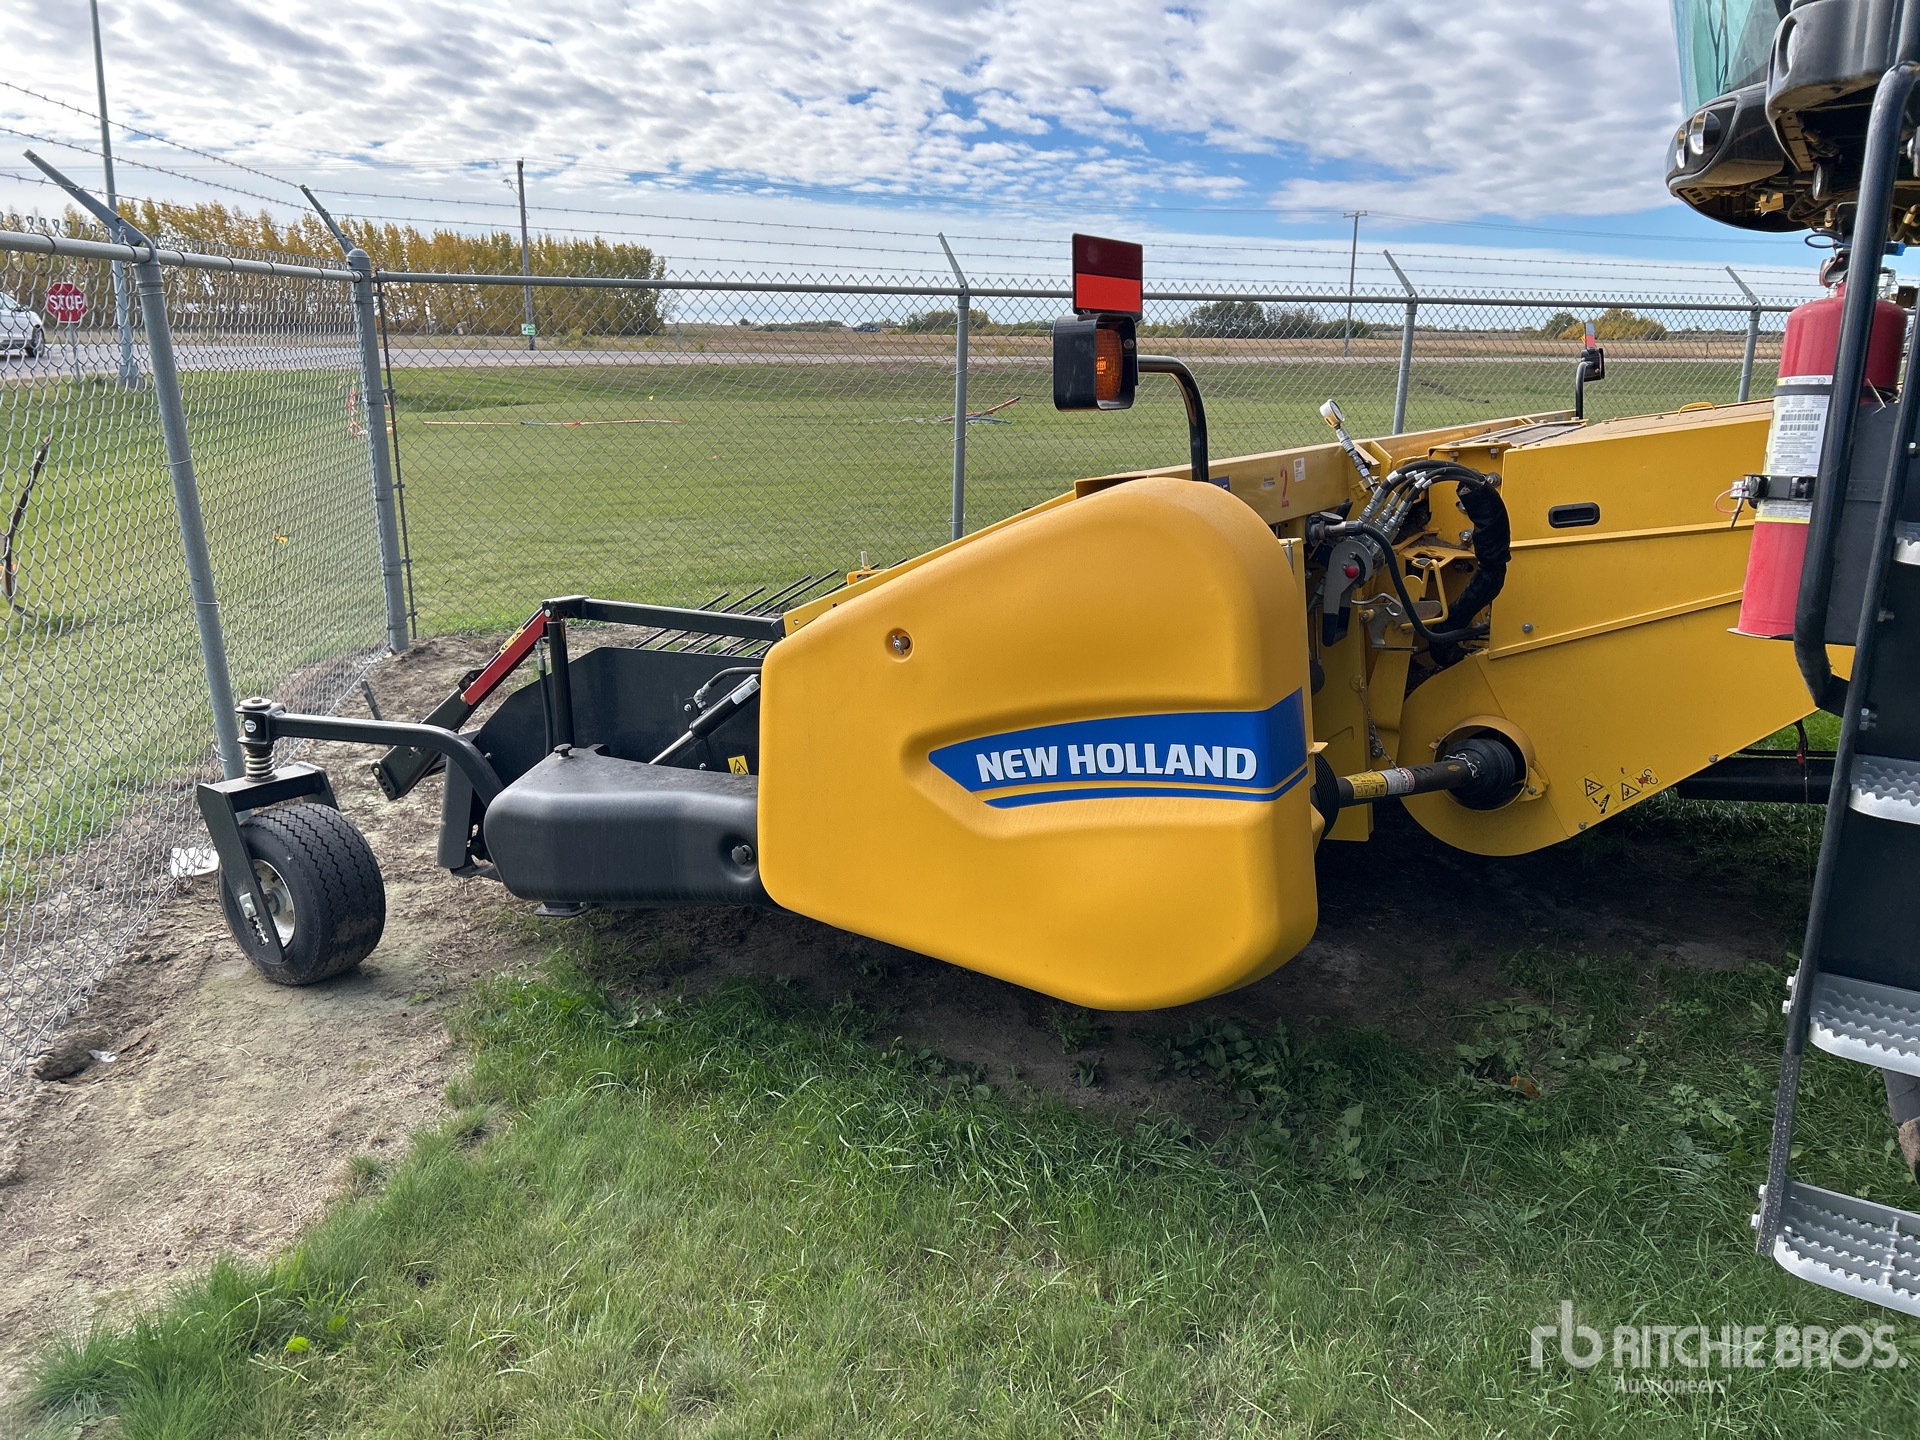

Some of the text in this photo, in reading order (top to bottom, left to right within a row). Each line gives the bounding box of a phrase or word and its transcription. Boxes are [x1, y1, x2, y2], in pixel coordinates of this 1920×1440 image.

[49, 294, 83, 311] STOP
[976, 743, 1257, 782] NEW HOLLAND
